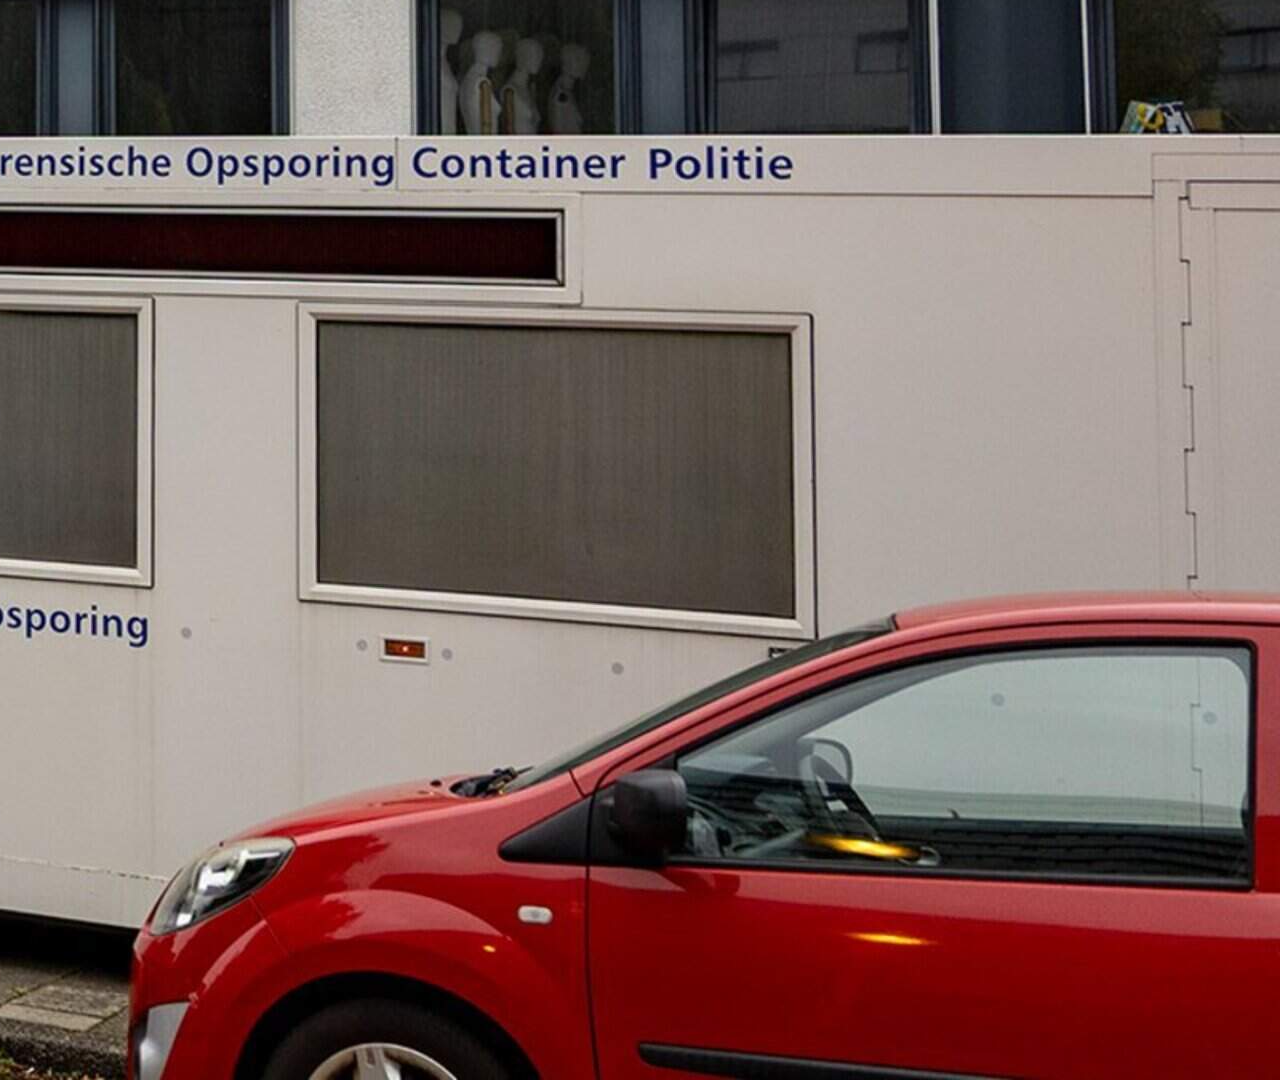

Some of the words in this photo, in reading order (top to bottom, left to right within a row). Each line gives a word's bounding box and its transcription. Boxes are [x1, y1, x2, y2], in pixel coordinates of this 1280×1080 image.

[186, 147, 395, 187] Opsporing
[410, 145, 625, 180] Container
[648, 146, 793, 180] Politie
